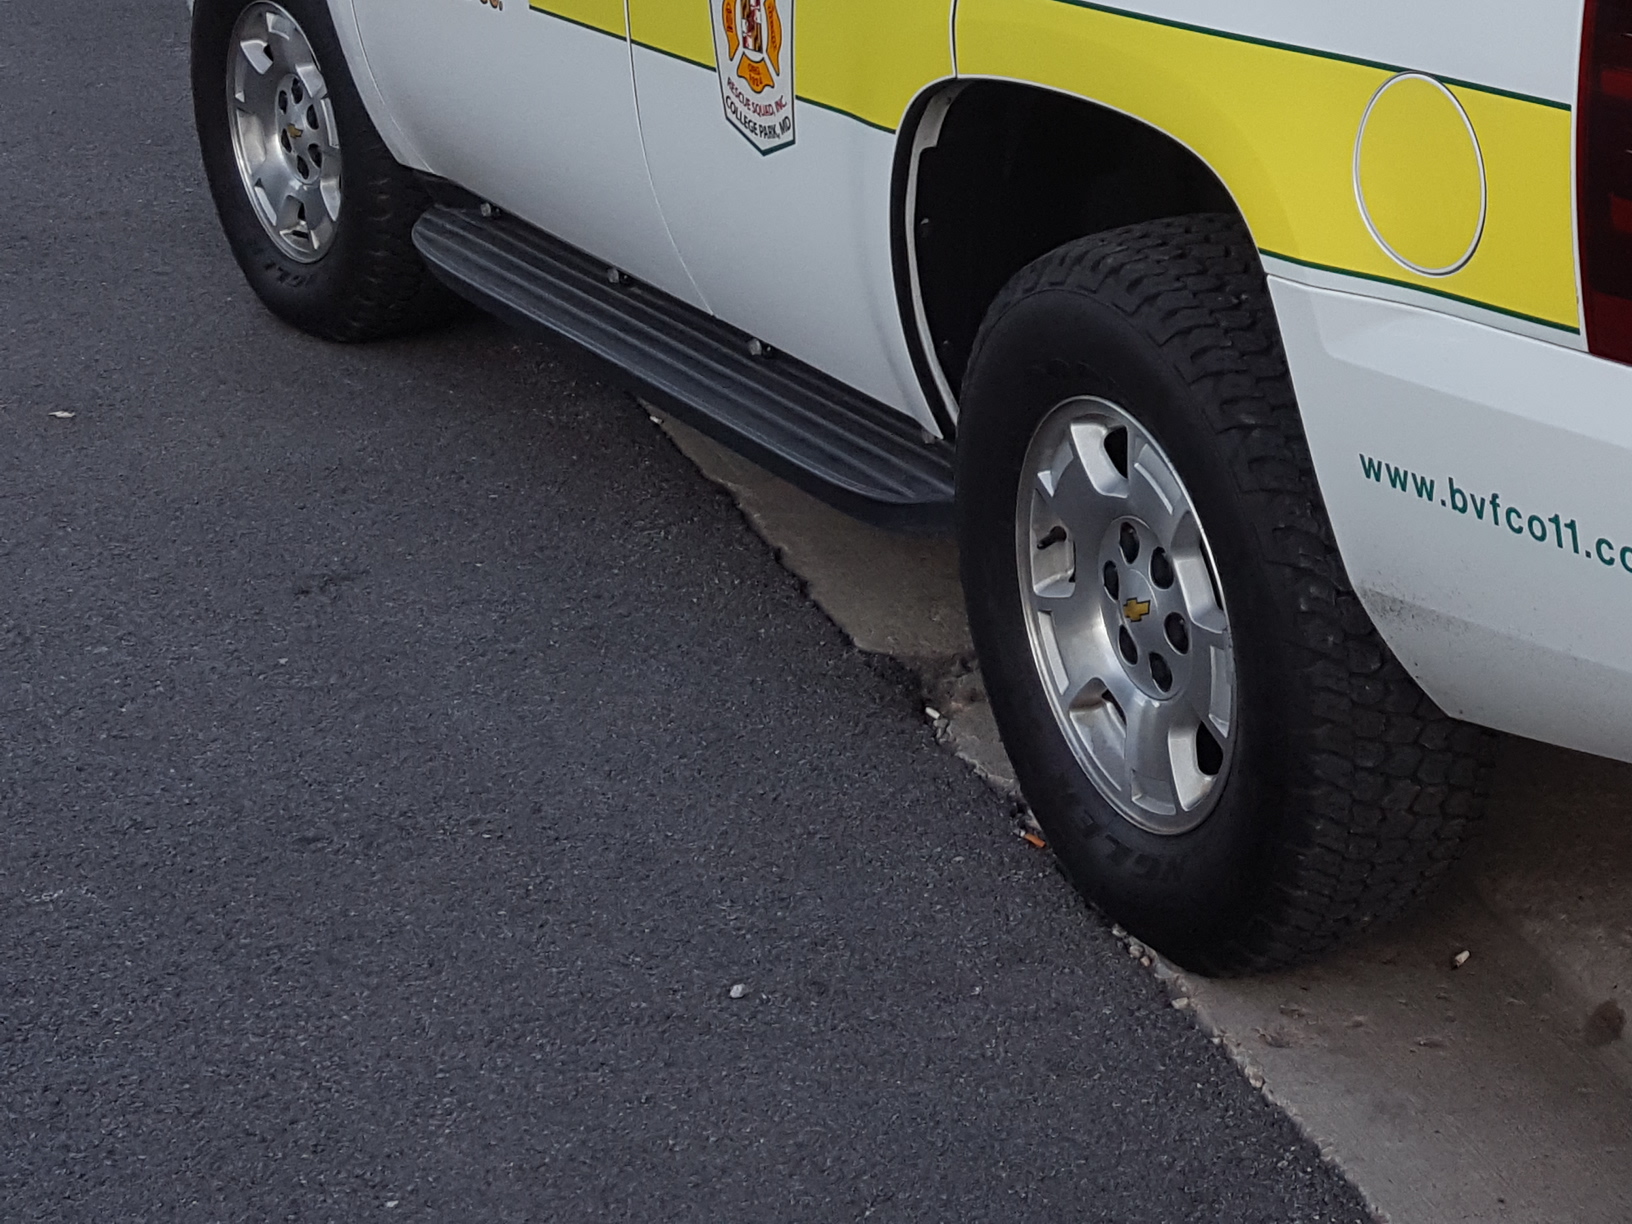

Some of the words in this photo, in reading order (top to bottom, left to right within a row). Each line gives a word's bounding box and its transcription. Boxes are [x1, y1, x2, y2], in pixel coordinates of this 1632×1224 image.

[727, 76, 751, 111] RESCUE
[725, 95, 758, 136] COLLEGE
[779, 116, 792, 136] MD
